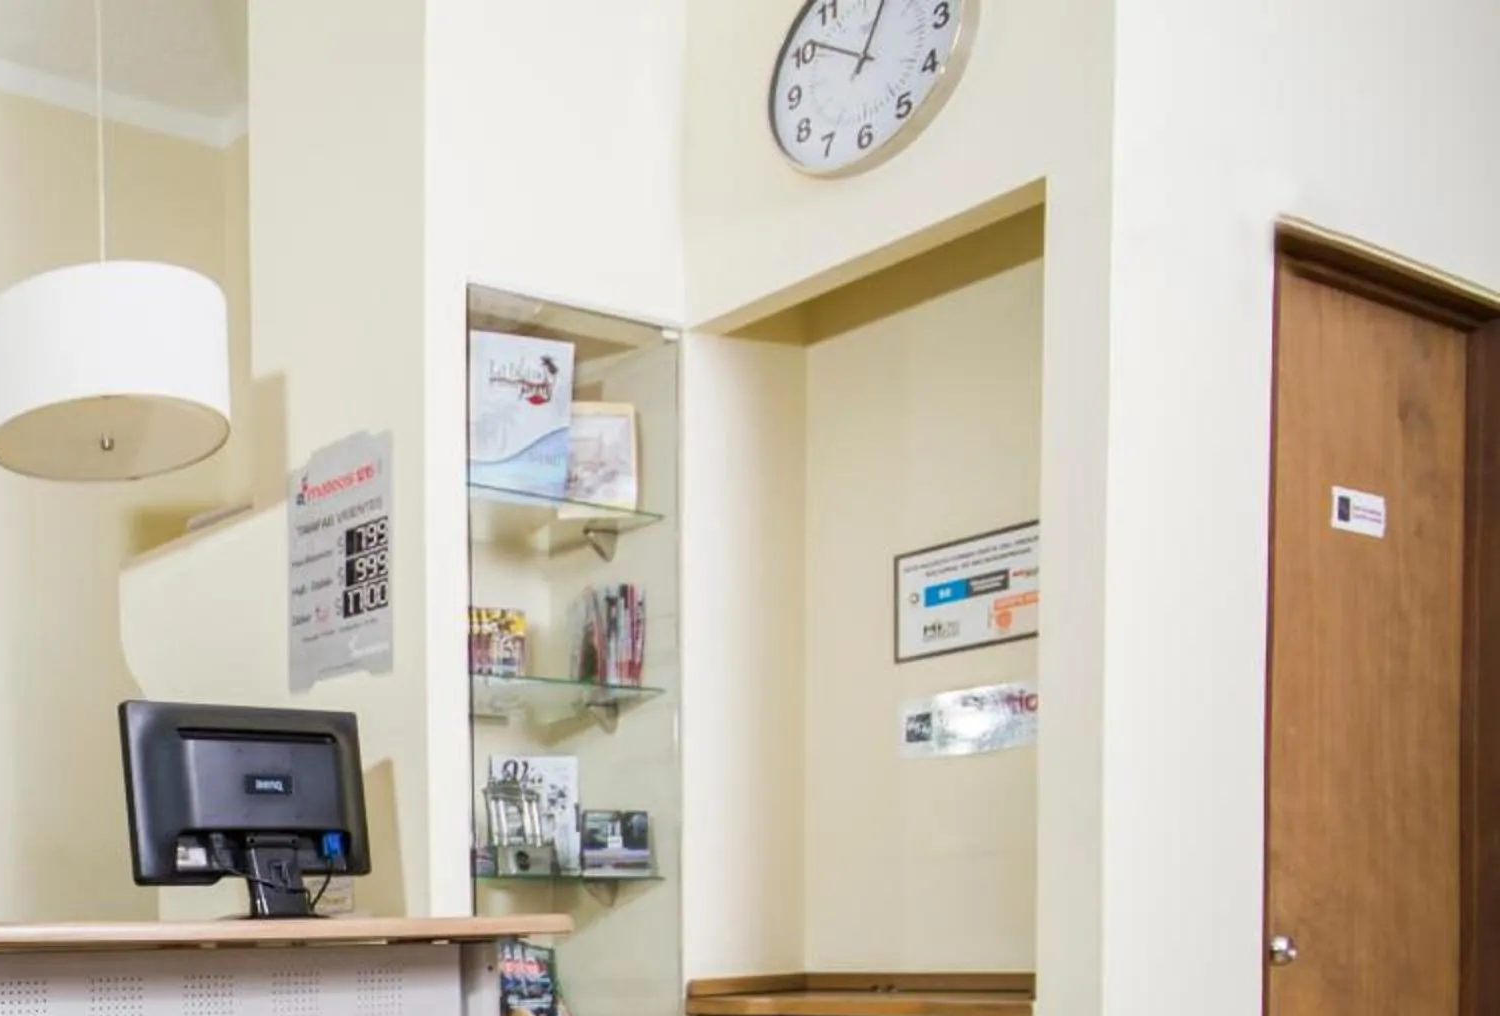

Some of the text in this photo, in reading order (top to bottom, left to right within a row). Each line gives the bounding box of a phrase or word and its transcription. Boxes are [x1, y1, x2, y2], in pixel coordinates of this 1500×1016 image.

[818, 0, 837, 26] 11
[932, 1, 950, 29] 3
[792, 40, 816, 69] 10
[921, 48, 940, 74] 4
[787, 85, 803, 110] 9
[896, 91, 912, 119] 5
[796, 118, 812, 142] 8
[857, 124, 873, 149] 6
[820, 131, 836, 158] 7
[355, 548, 388, 582] 999
